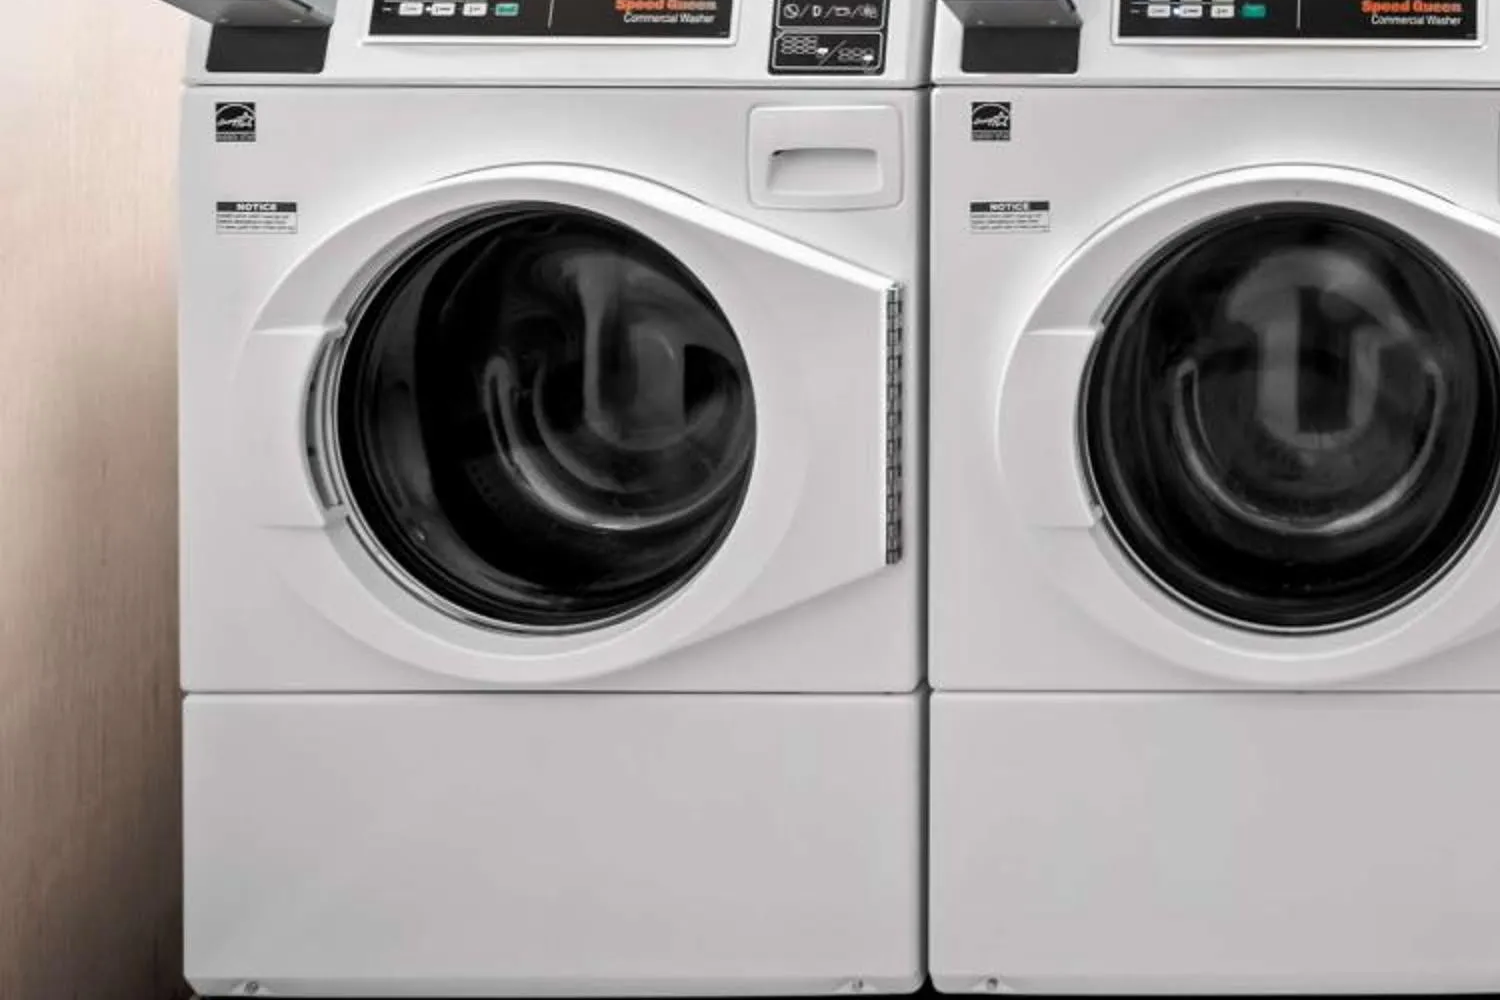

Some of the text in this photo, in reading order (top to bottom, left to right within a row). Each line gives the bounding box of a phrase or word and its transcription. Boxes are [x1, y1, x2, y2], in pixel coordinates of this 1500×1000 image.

[1361, 0, 1462, 15] Speed Queen
[623, 12, 716, 24] Commercial Washer
[1371, 15, 1463, 26] Commercial Washer
[236, 203, 277, 212] NOTICE
[989, 203, 1029, 212] NOTICE
